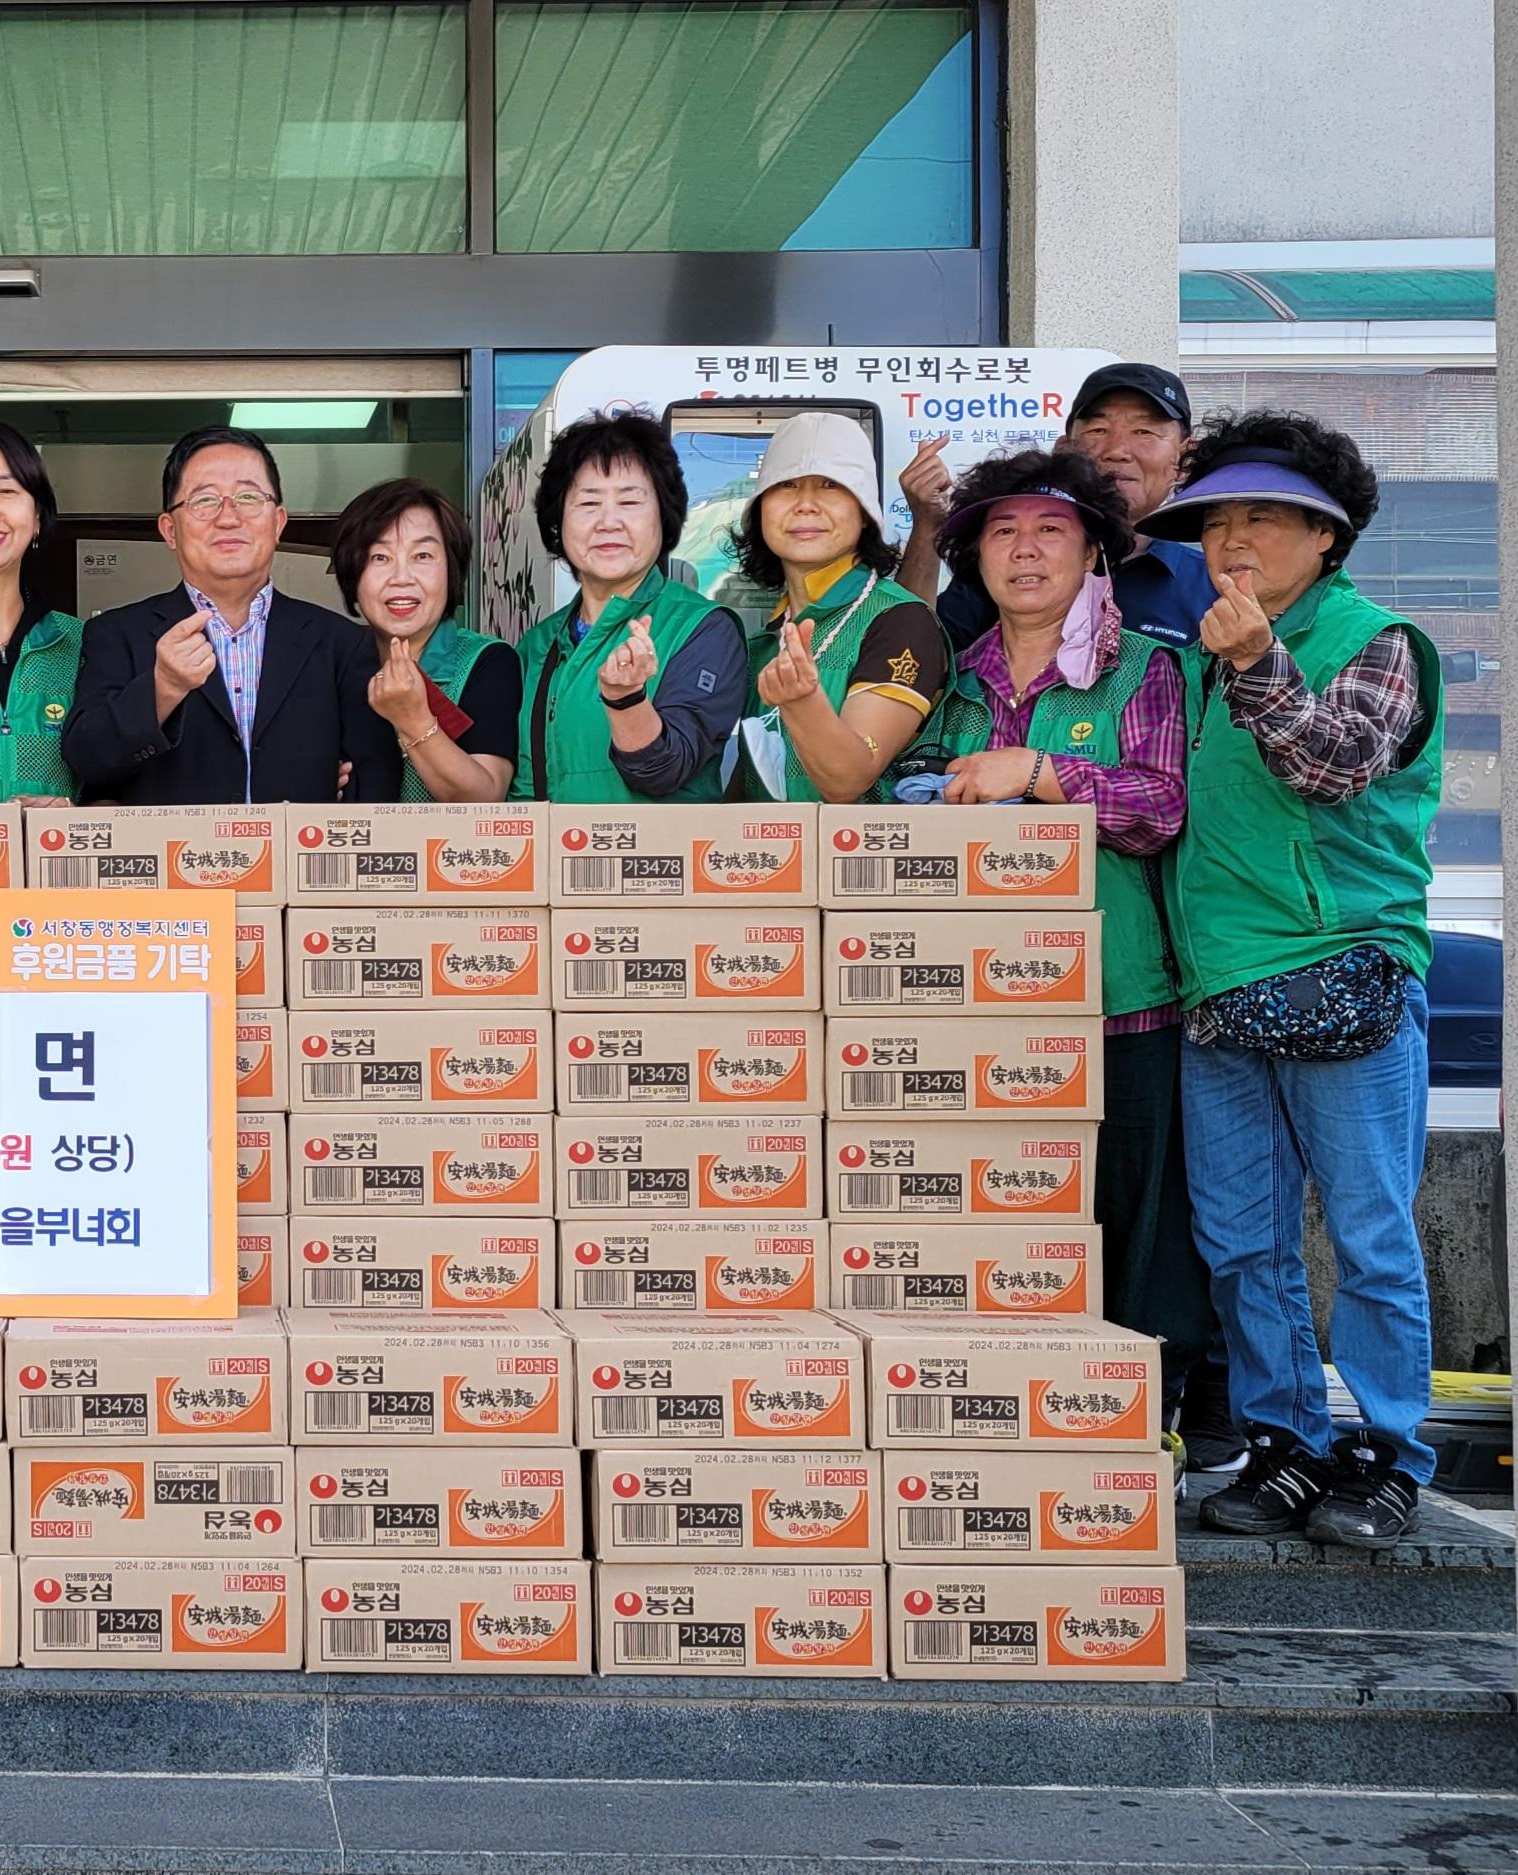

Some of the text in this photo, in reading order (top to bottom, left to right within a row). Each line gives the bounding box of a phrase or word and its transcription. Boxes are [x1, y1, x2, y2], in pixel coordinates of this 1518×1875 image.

[695, 357, 1031, 384] 투명페트병 무인회수로봇
[901, 393, 1063, 422] TogetheR
[971, 429, 998, 442] 실천
[1004, 429, 1059, 442] 프로젝트
[96, 555, 117, 565] 금연
[1065, 745, 1097, 755] SMU
[69, 833, 111, 850] 농심
[328, 831, 370, 847] 농심
[592, 833, 635, 850] 농심
[864, 833, 907, 850] 농심
[41, 919, 209, 938] 서창동행정복지센터
[333, 936, 375, 953] 농심
[596, 937, 638, 953] 농심
[870, 942, 914, 959] 농심
[11, 943, 211, 981] 후원금품 기탁
[332, 1040, 374, 1056] 농심
[599, 1040, 642, 1057] 농심
[872, 1048, 916, 1065] 농심
[51, 1133, 134, 1173] 상당)
[333, 1143, 376, 1160] 농심
[598, 1146, 641, 1163] 농심
[870, 1150, 914, 1167] 농심
[333, 1246, 376, 1262] 농심
[605, 1247, 648, 1264] 농심
[874, 1251, 918, 1268] 농심
[51, 1370, 97, 1388] 농심
[337, 1366, 383, 1385] 농심
[624, 1370, 671, 1389] 농심
[920, 1369, 967, 1388] 농심
[85, 1398, 145, 1415] 가3478
[371, 1396, 431, 1413] 가3478
[660, 1400, 720, 1417] 가3478
[954, 1400, 1015, 1417] 가3478
[157, 1483, 217, 1500] 가3478
[342, 1479, 388, 1497] 농심
[645, 1478, 691, 1497] 농심
[931, 1482, 978, 1500] 농심
[205, 1511, 250, 1529] 농심
[376, 1508, 436, 1525] 가3478
[679, 1508, 739, 1525] 가3478
[966, 1512, 1027, 1529] 가3478
[65, 1583, 111, 1602] 농심
[353, 1593, 399, 1612] 농심
[646, 1597, 693, 1615] 농심
[937, 1595, 985, 1614] 농심
[99, 1613, 159, 1630] 가3478
[387, 1623, 448, 1640] 가3478
[681, 1627, 742, 1644] 가3478
[972, 1625, 1034, 1642] 가3478
